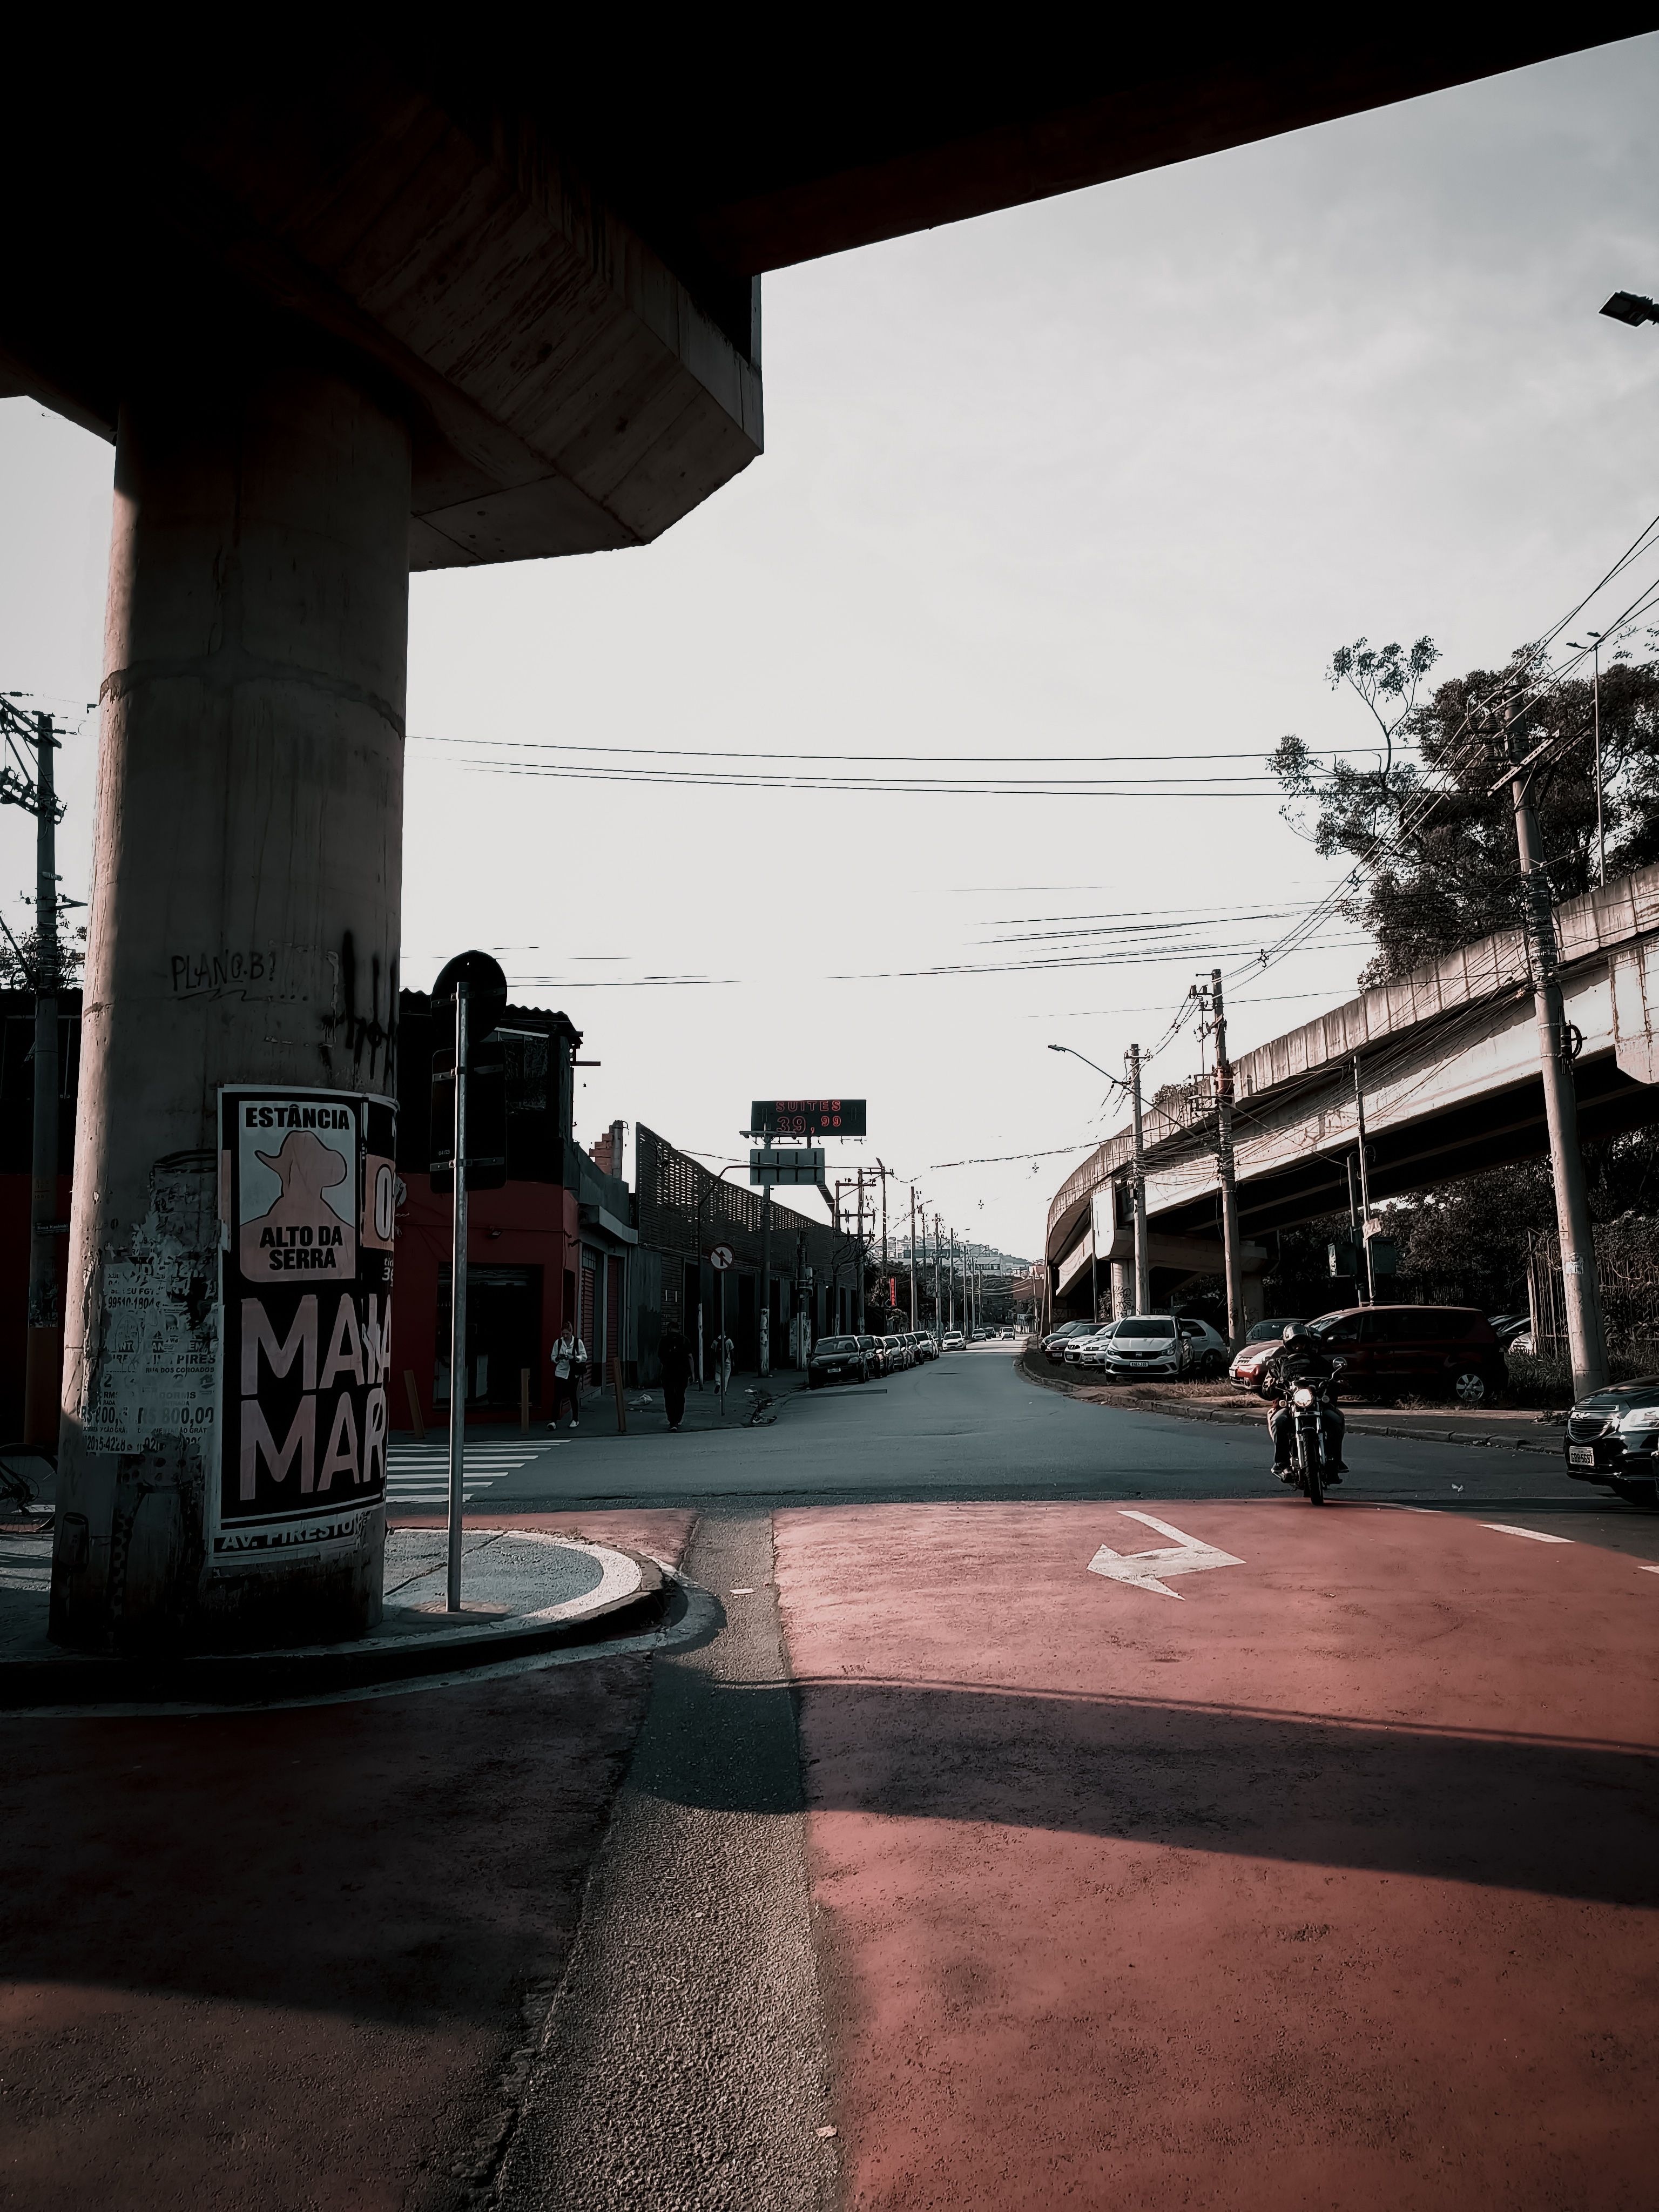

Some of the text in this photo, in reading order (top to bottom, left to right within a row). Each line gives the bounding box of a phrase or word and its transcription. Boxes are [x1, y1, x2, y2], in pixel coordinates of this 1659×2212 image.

[245, 1103, 350, 1130] ESTÂNCIA
[776, 1101, 841, 1112] SUITES
[375, 1163, 395, 1242] 0
[259, 1225, 343, 1248] ALTO DA
[269, 1247, 337, 1270] SERRA
[177, 1354, 216, 1365] PIRES
[221, 1535, 258, 1550] AV.
